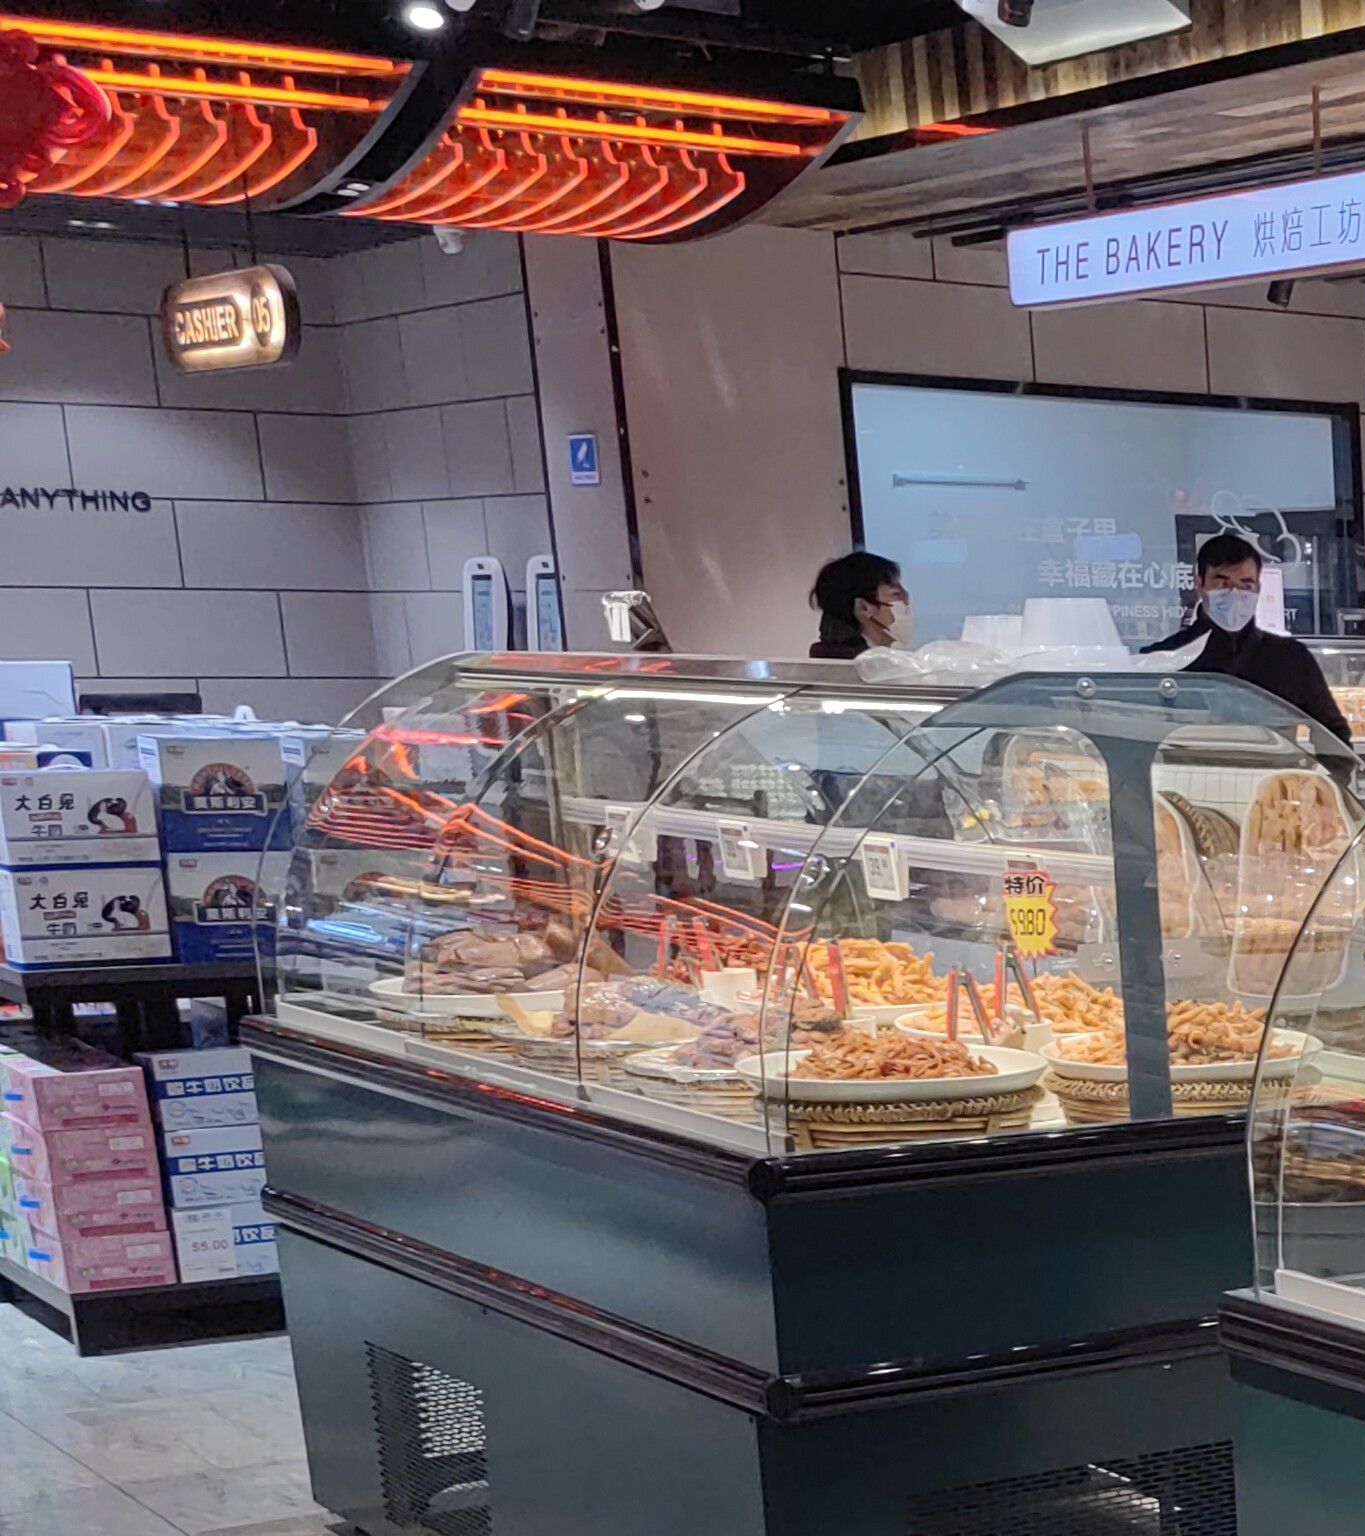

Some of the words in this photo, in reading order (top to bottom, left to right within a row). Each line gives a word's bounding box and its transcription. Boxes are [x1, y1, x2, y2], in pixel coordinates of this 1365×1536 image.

[1036, 241, 1090, 285] THE
[1105, 219, 1229, 275] BAKERY
[1252, 198, 1363, 258] 烘焙工坊
[174, 304, 239, 345] CASHIER
[252, 297, 271, 334] 05
[0, 485, 152, 513] ANYTHING
[1004, 875, 1045, 895] 特价
